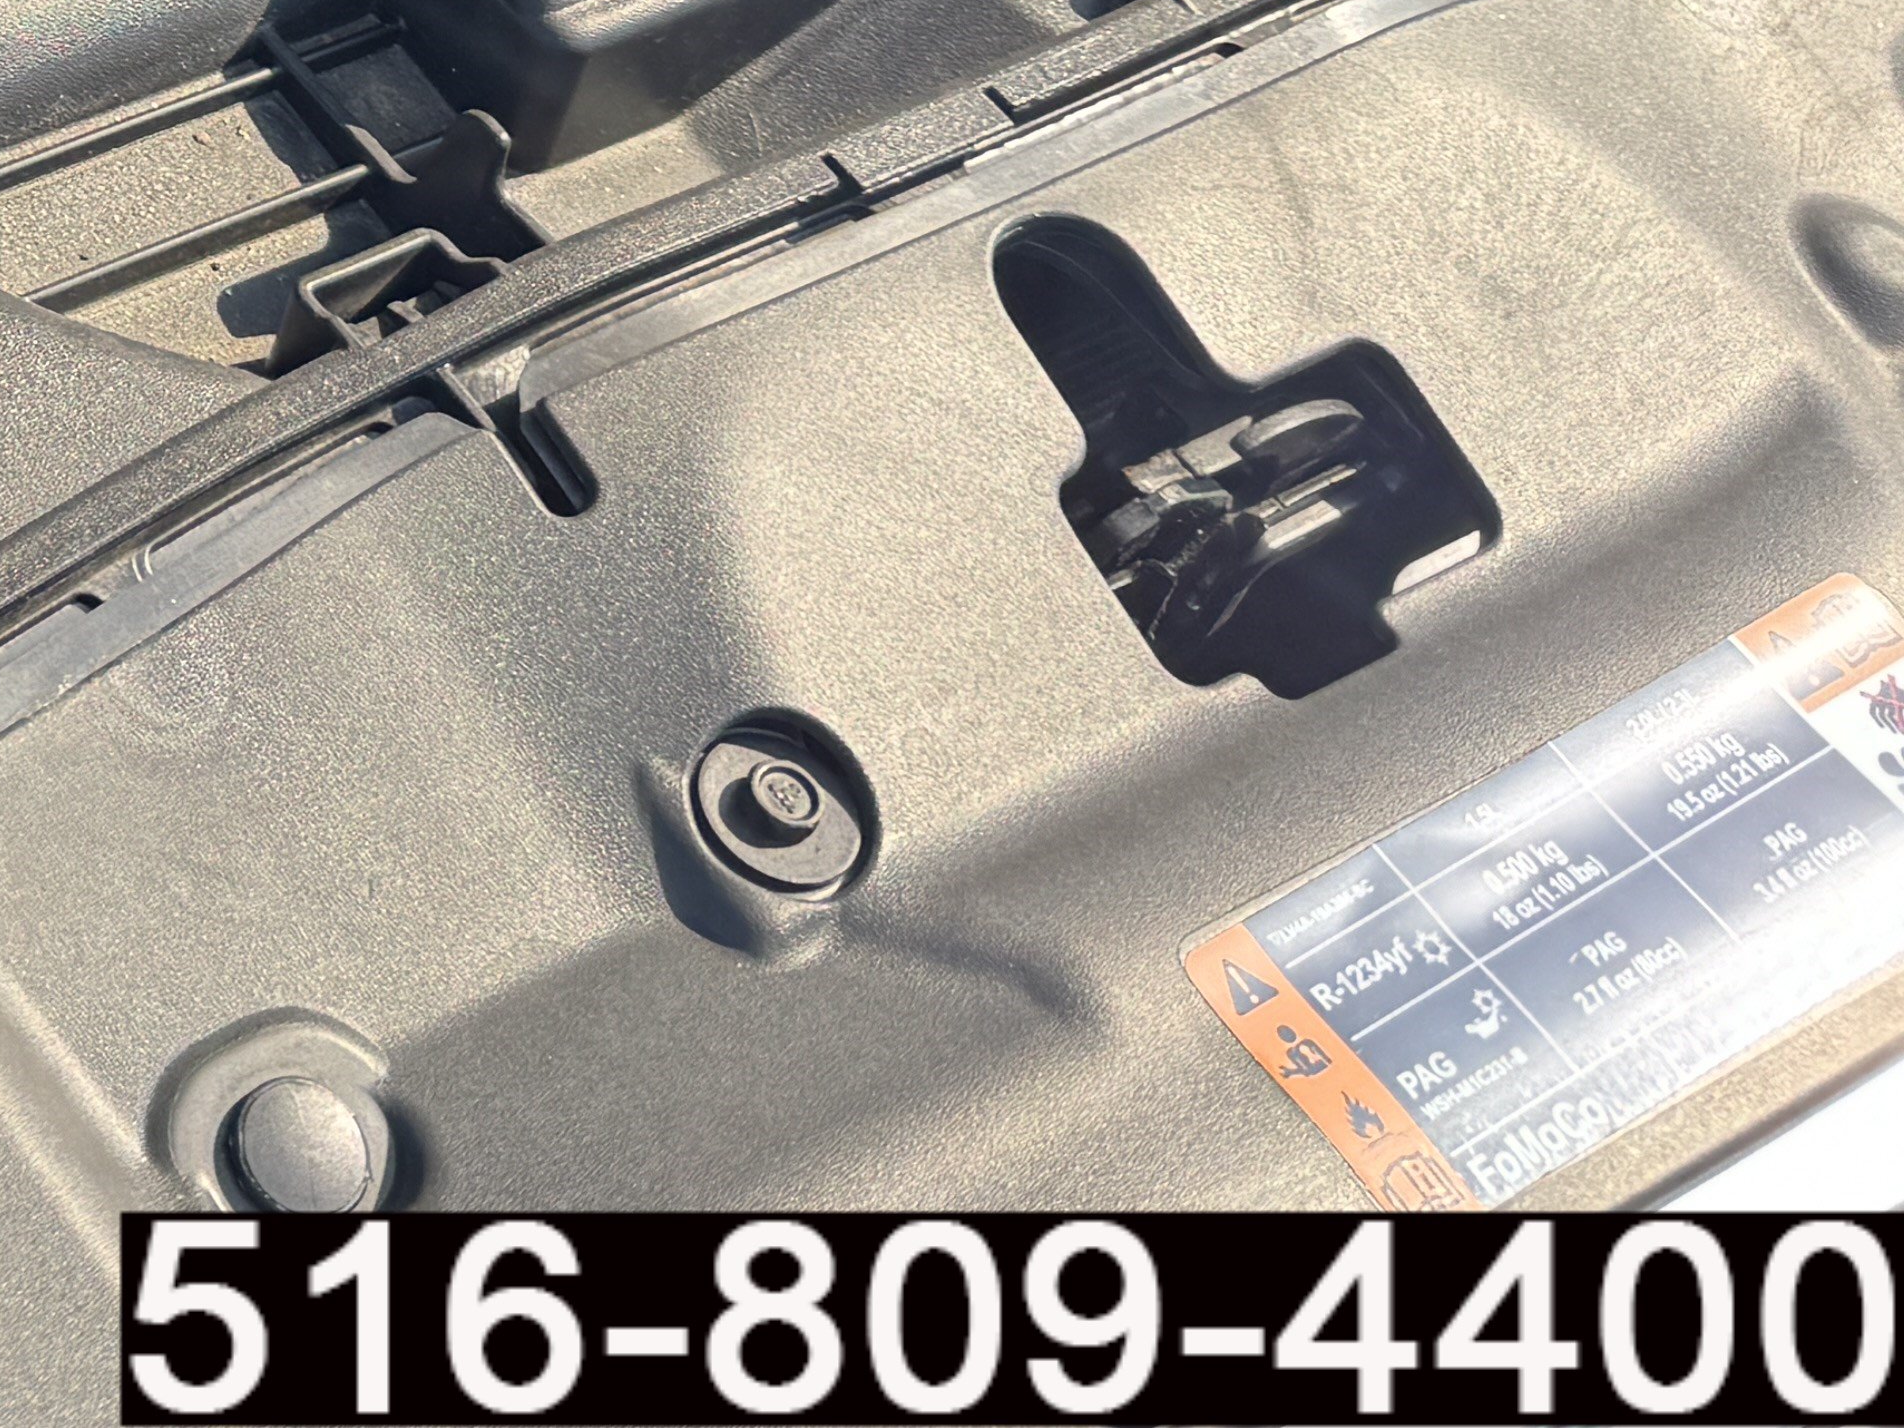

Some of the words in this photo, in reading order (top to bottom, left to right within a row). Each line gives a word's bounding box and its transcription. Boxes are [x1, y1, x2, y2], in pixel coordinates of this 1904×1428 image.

[1661, 745, 1718, 786] 0.550
[1713, 732, 1747, 759] kg
[1666, 789, 1706, 822] 19.5
[1699, 781, 1726, 804] oz
[1750, 741, 1792, 773] lbs)
[1762, 821, 1808, 861] PAG
[1482, 848, 1540, 895] 0.500
[1527, 840, 1569, 868] kg
[1492, 903, 1520, 930] 18
[1514, 895, 1542, 920] oz
[1532, 871, 1577, 912] (1.10
[1568, 853, 1610, 886] lbs)
[1792, 857, 1819, 883] oz
[1308, 934, 1414, 1012] R-1234yf
[1580, 930, 1628, 967] PAG
[1614, 965, 1640, 991] oz
[1395, 1050, 1458, 1101] PAG
